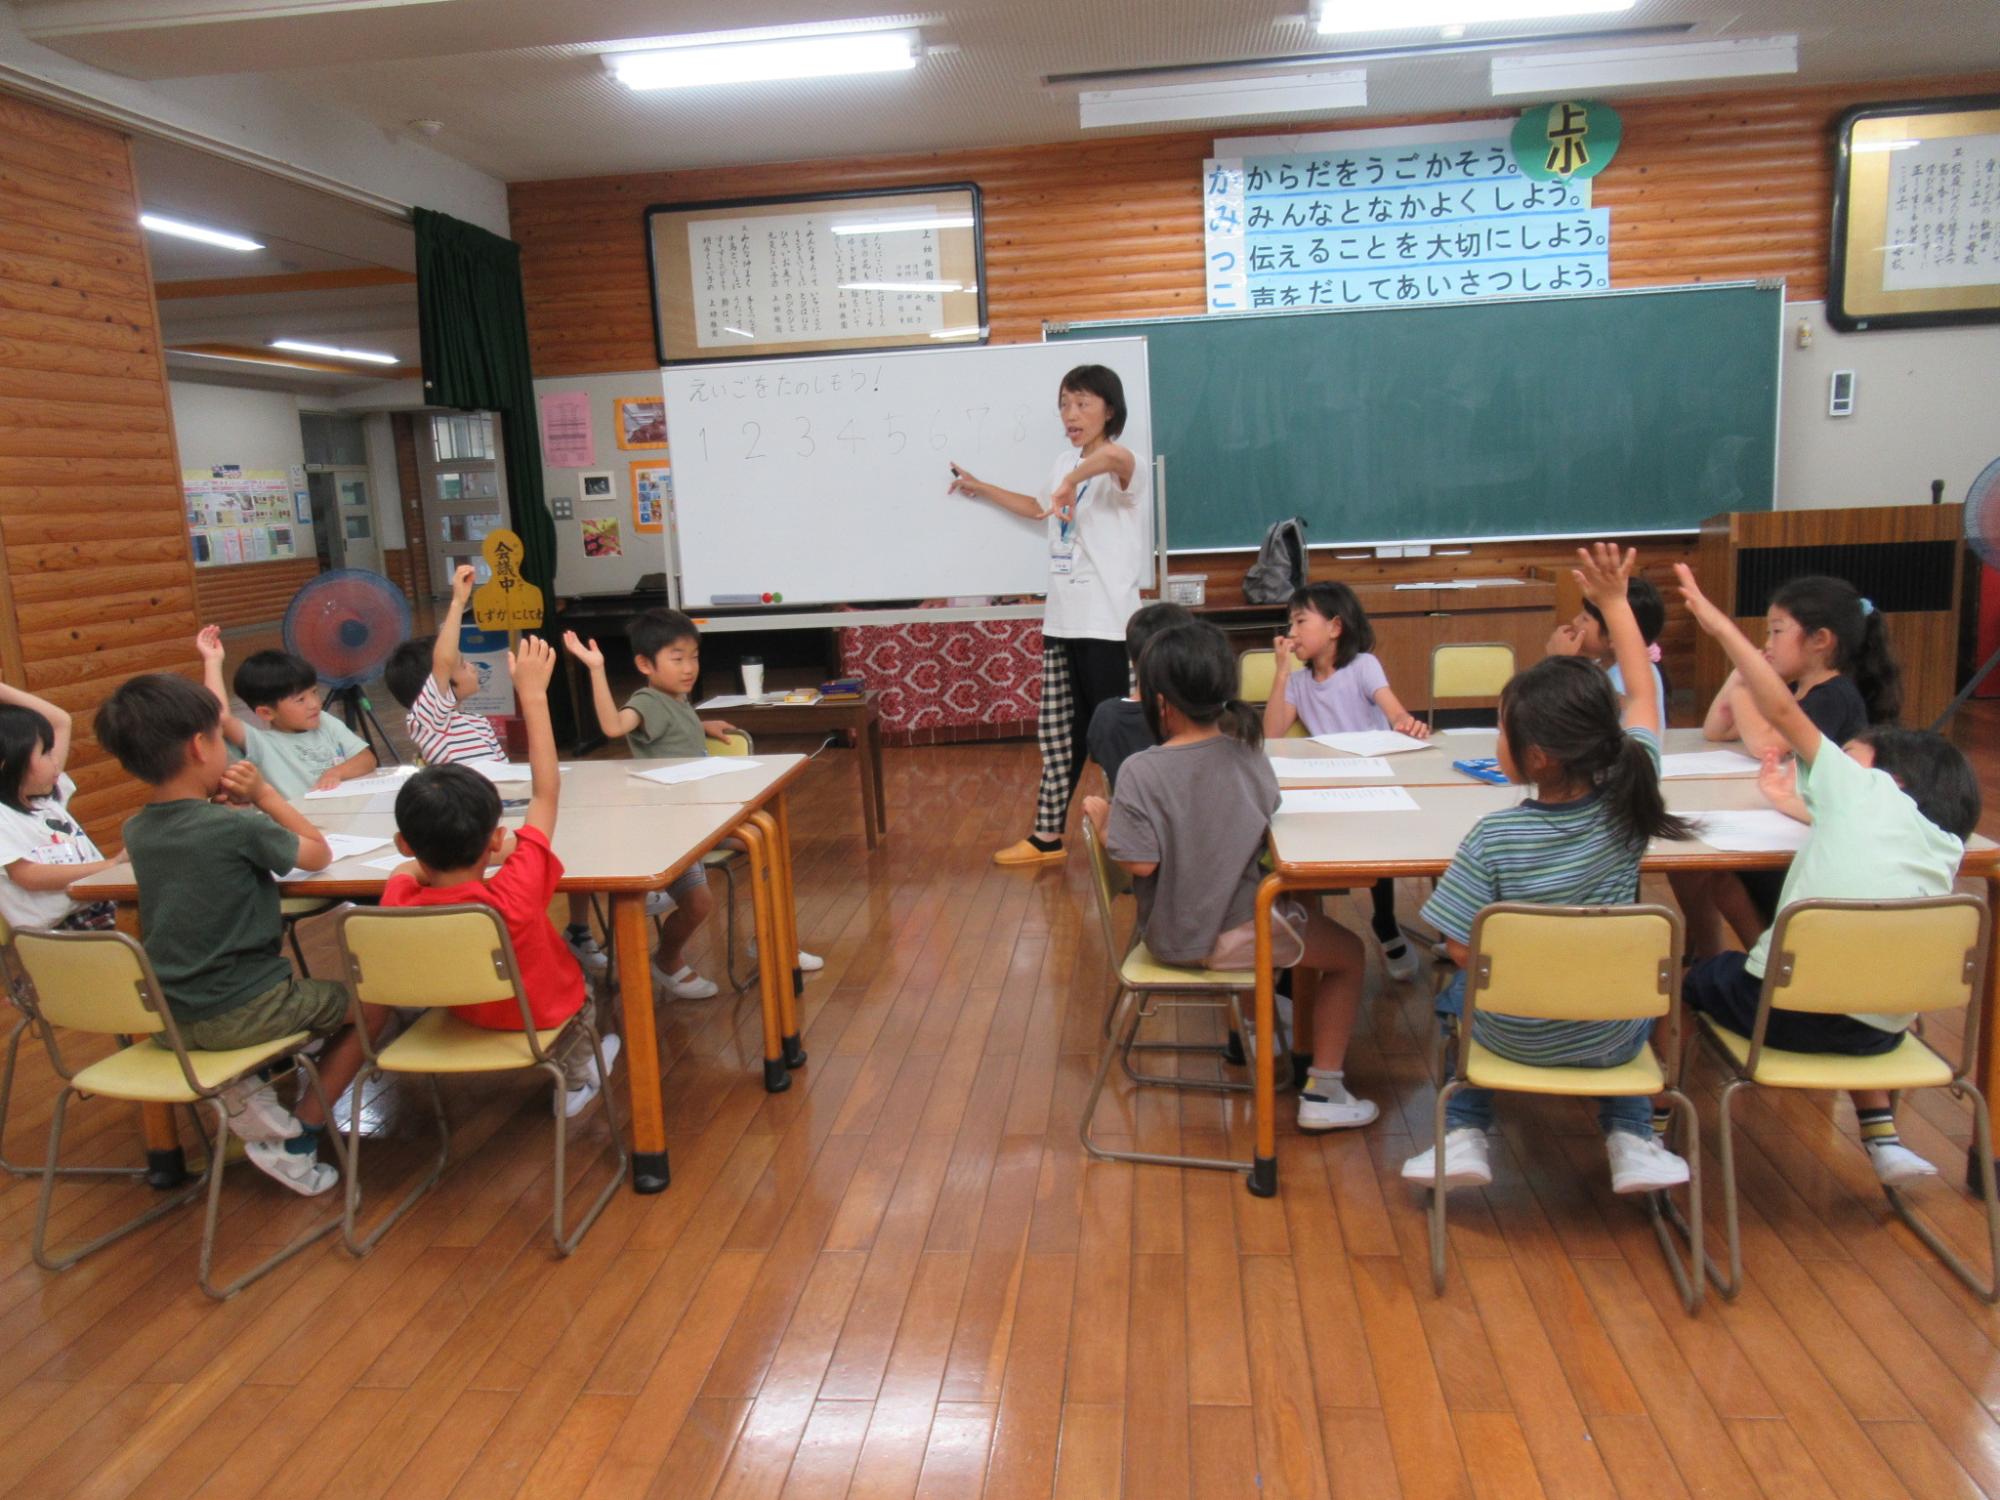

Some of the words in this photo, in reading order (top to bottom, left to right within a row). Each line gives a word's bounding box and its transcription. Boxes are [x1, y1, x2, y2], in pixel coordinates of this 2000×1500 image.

[1545, 104, 1588, 174] 上小
[1247, 147, 1519, 192] からだをうごかそう。
[1247, 180, 1581, 230] みんなとなかよくしよう。
[1248, 219, 1607, 272] 伝えることを大切にしよう。
[1249, 262, 1607, 309] 声をだしてあいさつしよう。
[699, 426, 708, 462] 1
[741, 420, 767, 460] 2
[795, 416, 816, 457] 3
[836, 417, 866, 455] 4
[882, 411, 907, 455] 5
[929, 408, 949, 451] 6
[494, 540, 518, 594] 会議中
